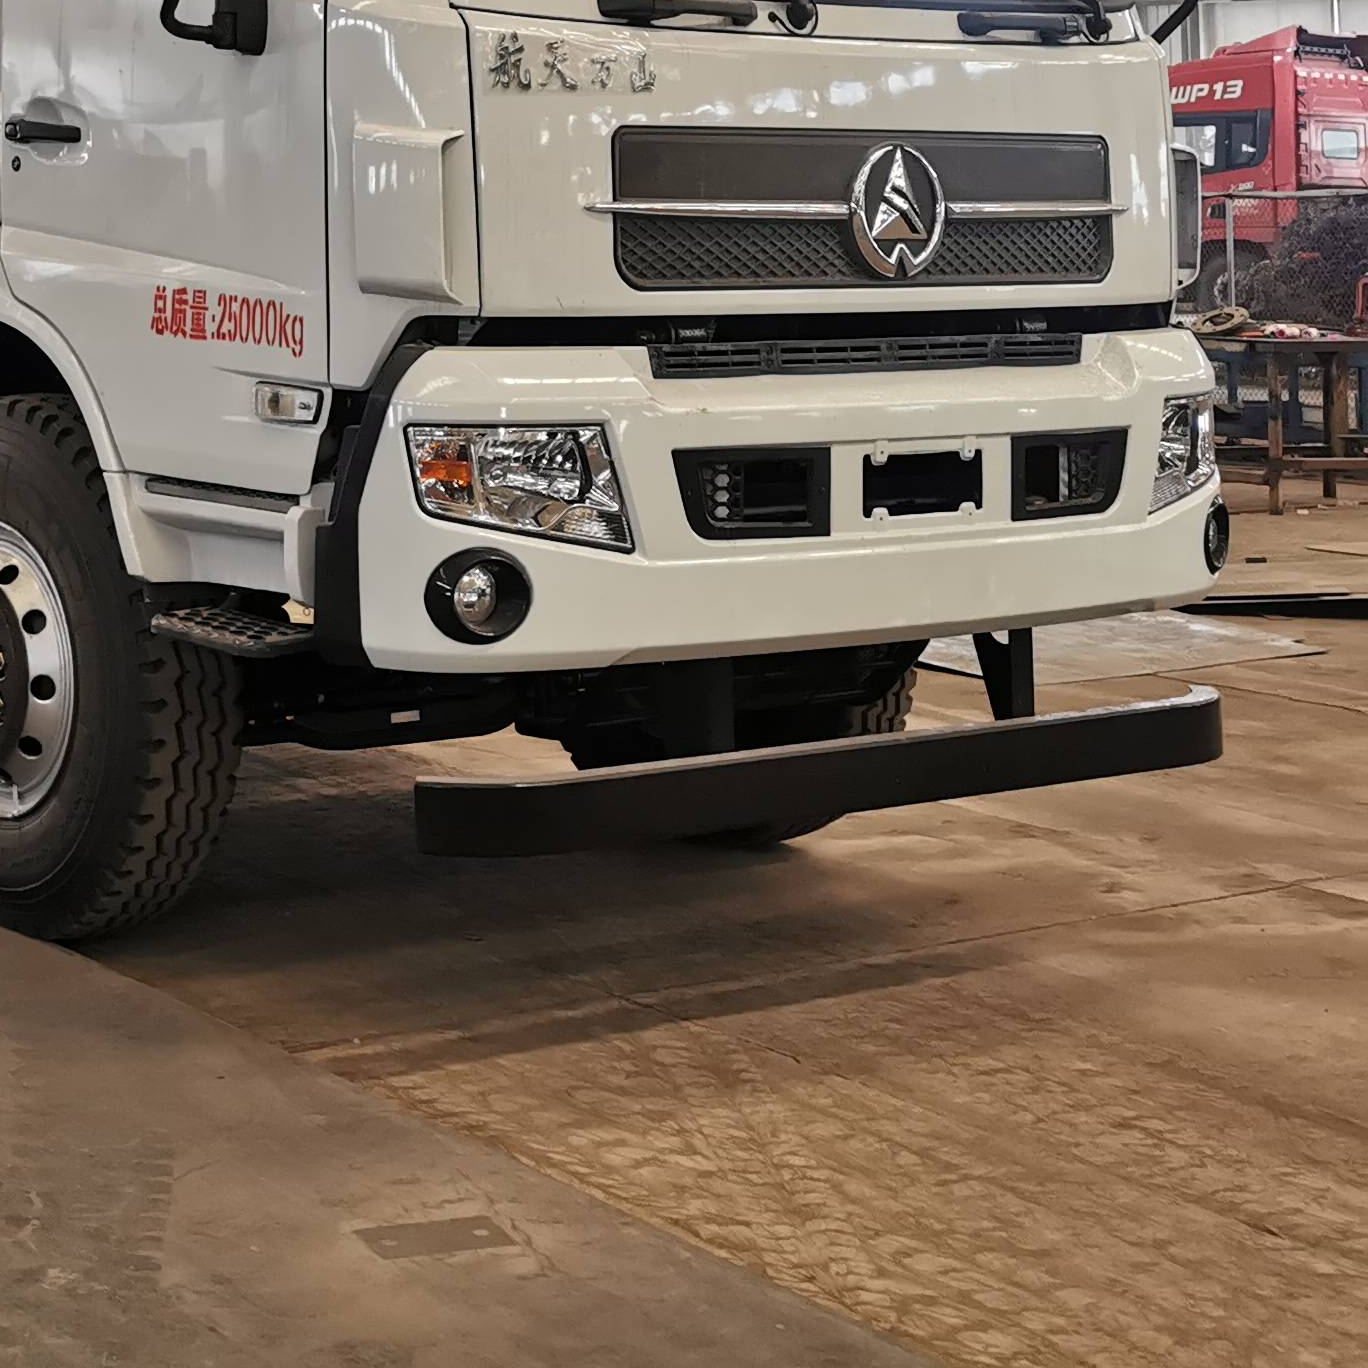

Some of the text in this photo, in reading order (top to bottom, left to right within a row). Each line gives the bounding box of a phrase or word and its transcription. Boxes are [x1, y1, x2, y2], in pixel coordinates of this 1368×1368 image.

[489, 31, 657, 93] 航天万山
[150, 285, 304, 358] 总质量:25000kg
